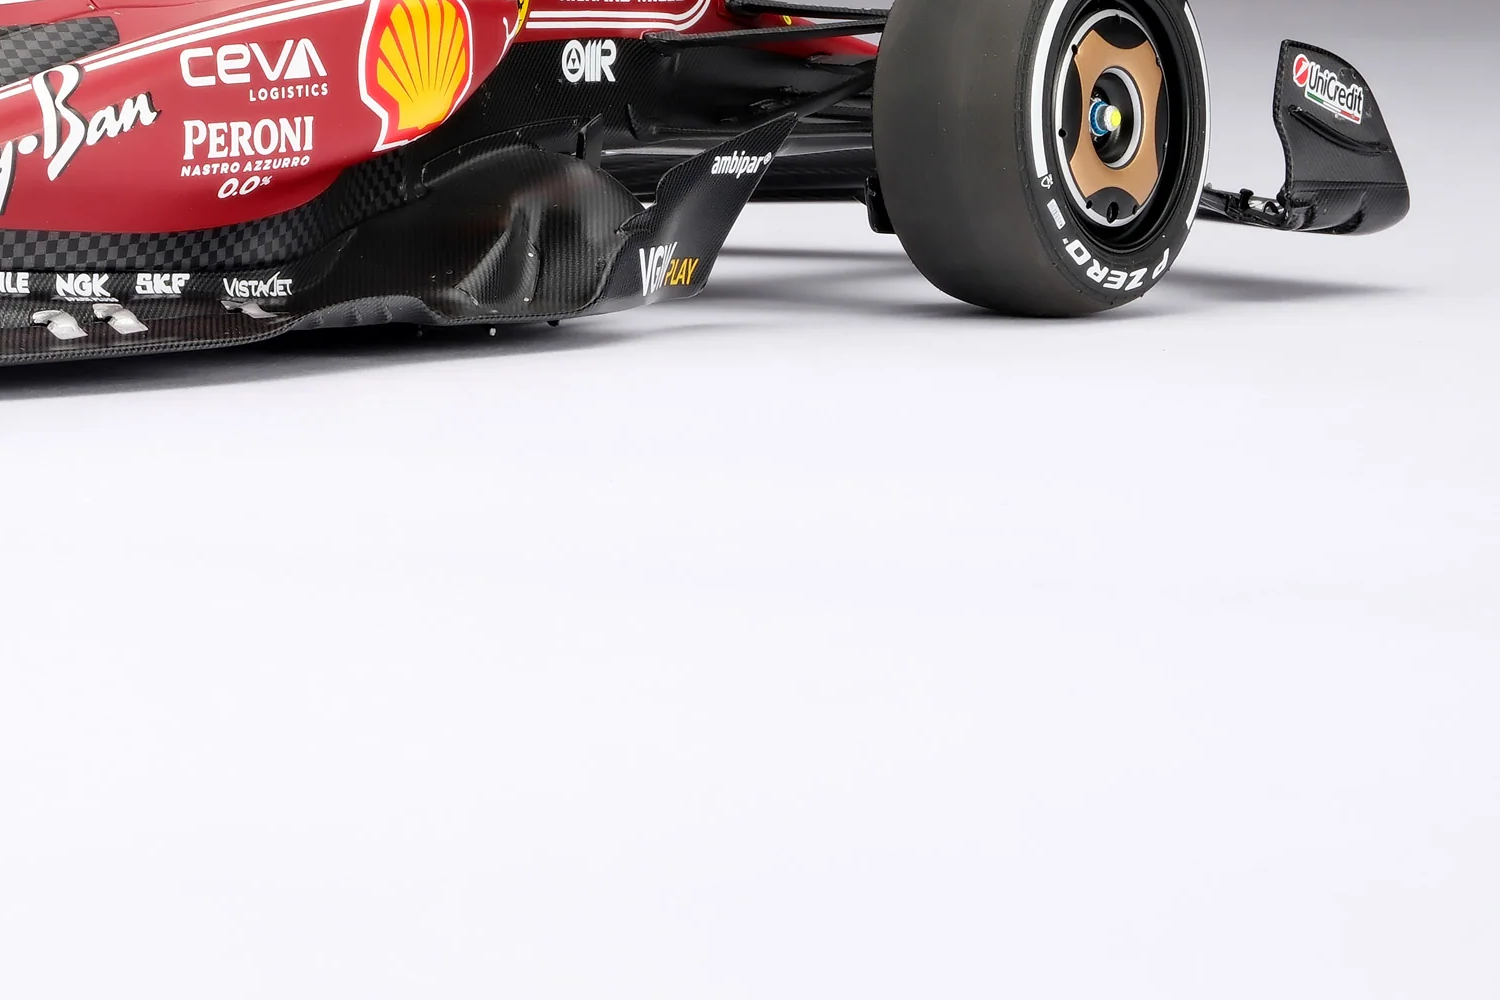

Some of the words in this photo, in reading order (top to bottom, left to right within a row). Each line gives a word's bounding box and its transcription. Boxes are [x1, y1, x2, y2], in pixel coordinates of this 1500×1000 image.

[249, 83, 328, 102] LOGISTICS
[1308, 62, 1363, 115] UniCredit
[183, 116, 314, 160] PERONI
[180, 161, 240, 177] NASTRO
[243, 155, 311, 173] AZZURRO
[217, 174, 273, 199] 0.0%
[1065, 238, 1148, 291] ZERO
[1152, 248, 1170, 279] P
[56, 273, 111, 297] NGK
[135, 273, 190, 294] SKF
